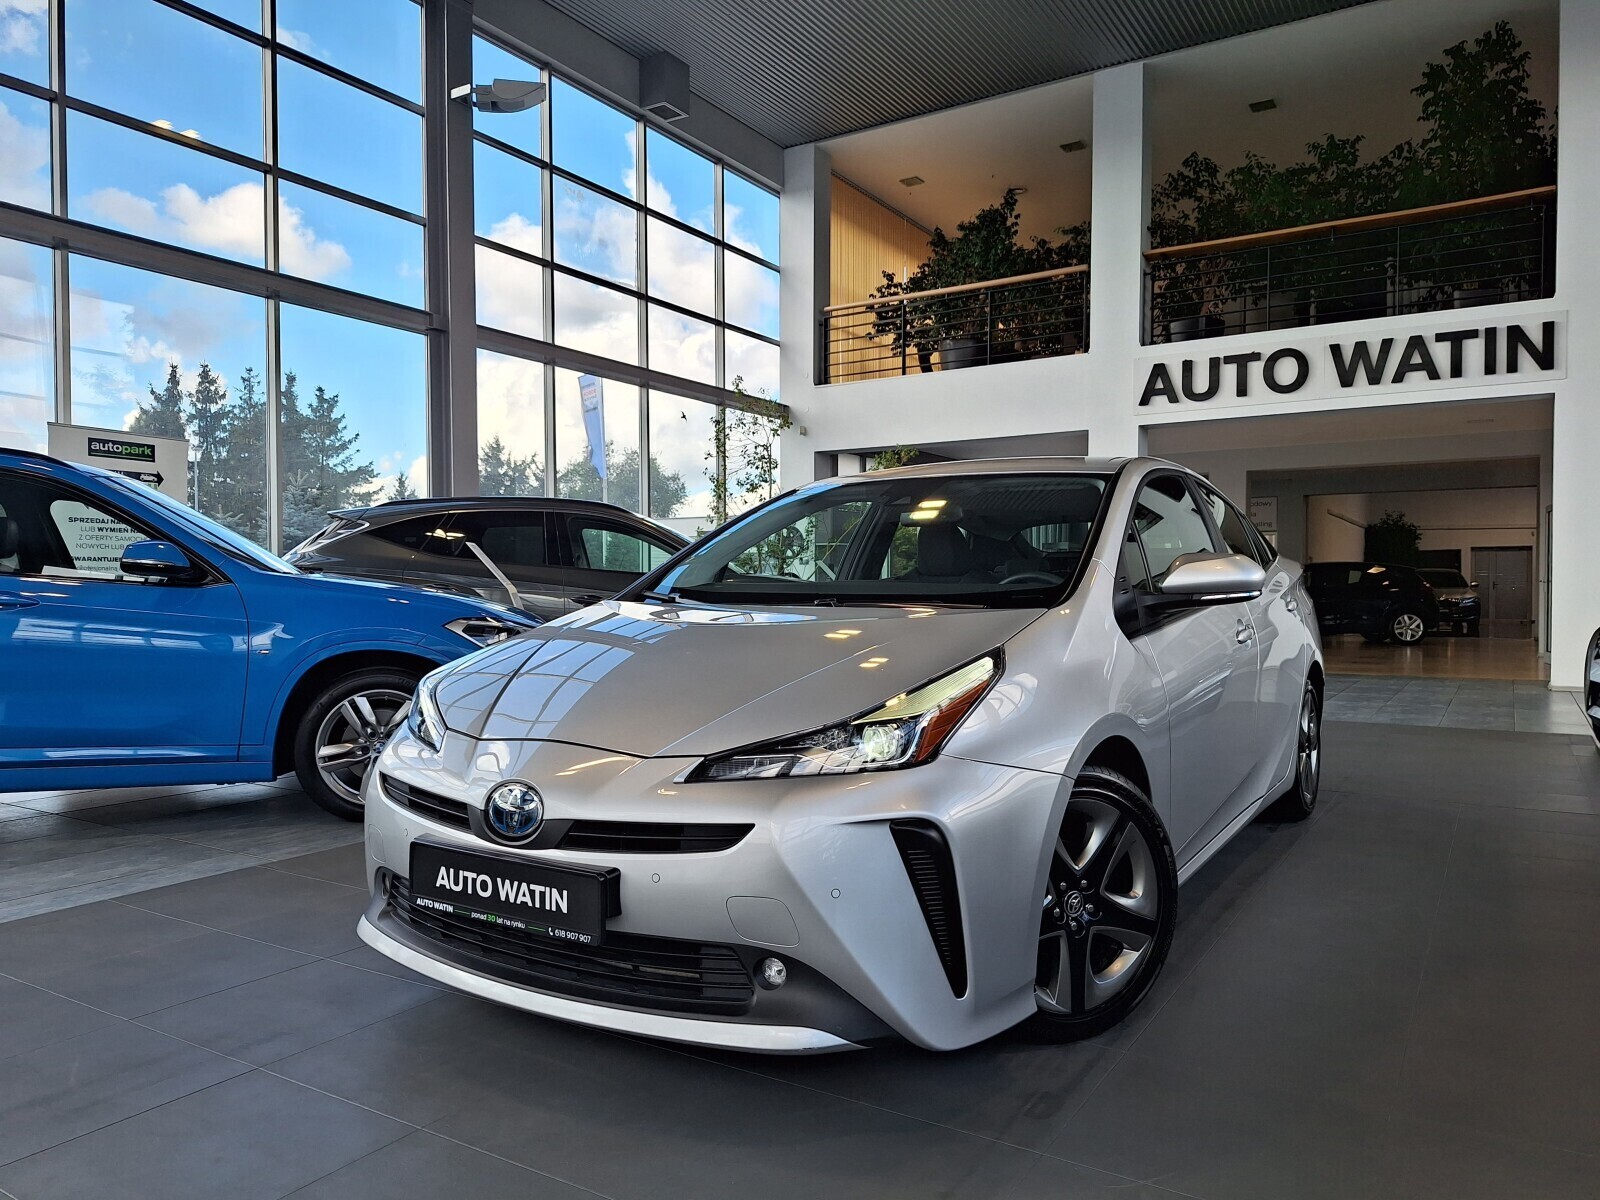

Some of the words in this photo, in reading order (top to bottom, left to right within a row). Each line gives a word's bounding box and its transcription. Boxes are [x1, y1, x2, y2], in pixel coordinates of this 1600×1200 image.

[1138, 347, 1310, 407] AUTO
[1328, 320, 1556, 388] WATIN
[91, 441, 152, 455] autopark
[68, 516, 109, 524] SPRZEDAJ
[110, 517, 124, 525] NA
[97, 525, 129, 534] WYMIEŃ
[75, 542, 110, 550] NOWYCH
[435, 866, 493, 898] AUTO
[496, 877, 568, 914] WATIN
[416, 897, 433, 908] AUTO
[433, 901, 454, 913] WATIN
[470, 911, 487, 921] ponad
[487, 914, 496, 922] 30
[496, 916, 504, 924] lat
[511, 920, 526, 929] rynku
[554, 929, 566, 938] 618
[566, 931, 578, 940] 907
[579, 934, 591, 943] 907
